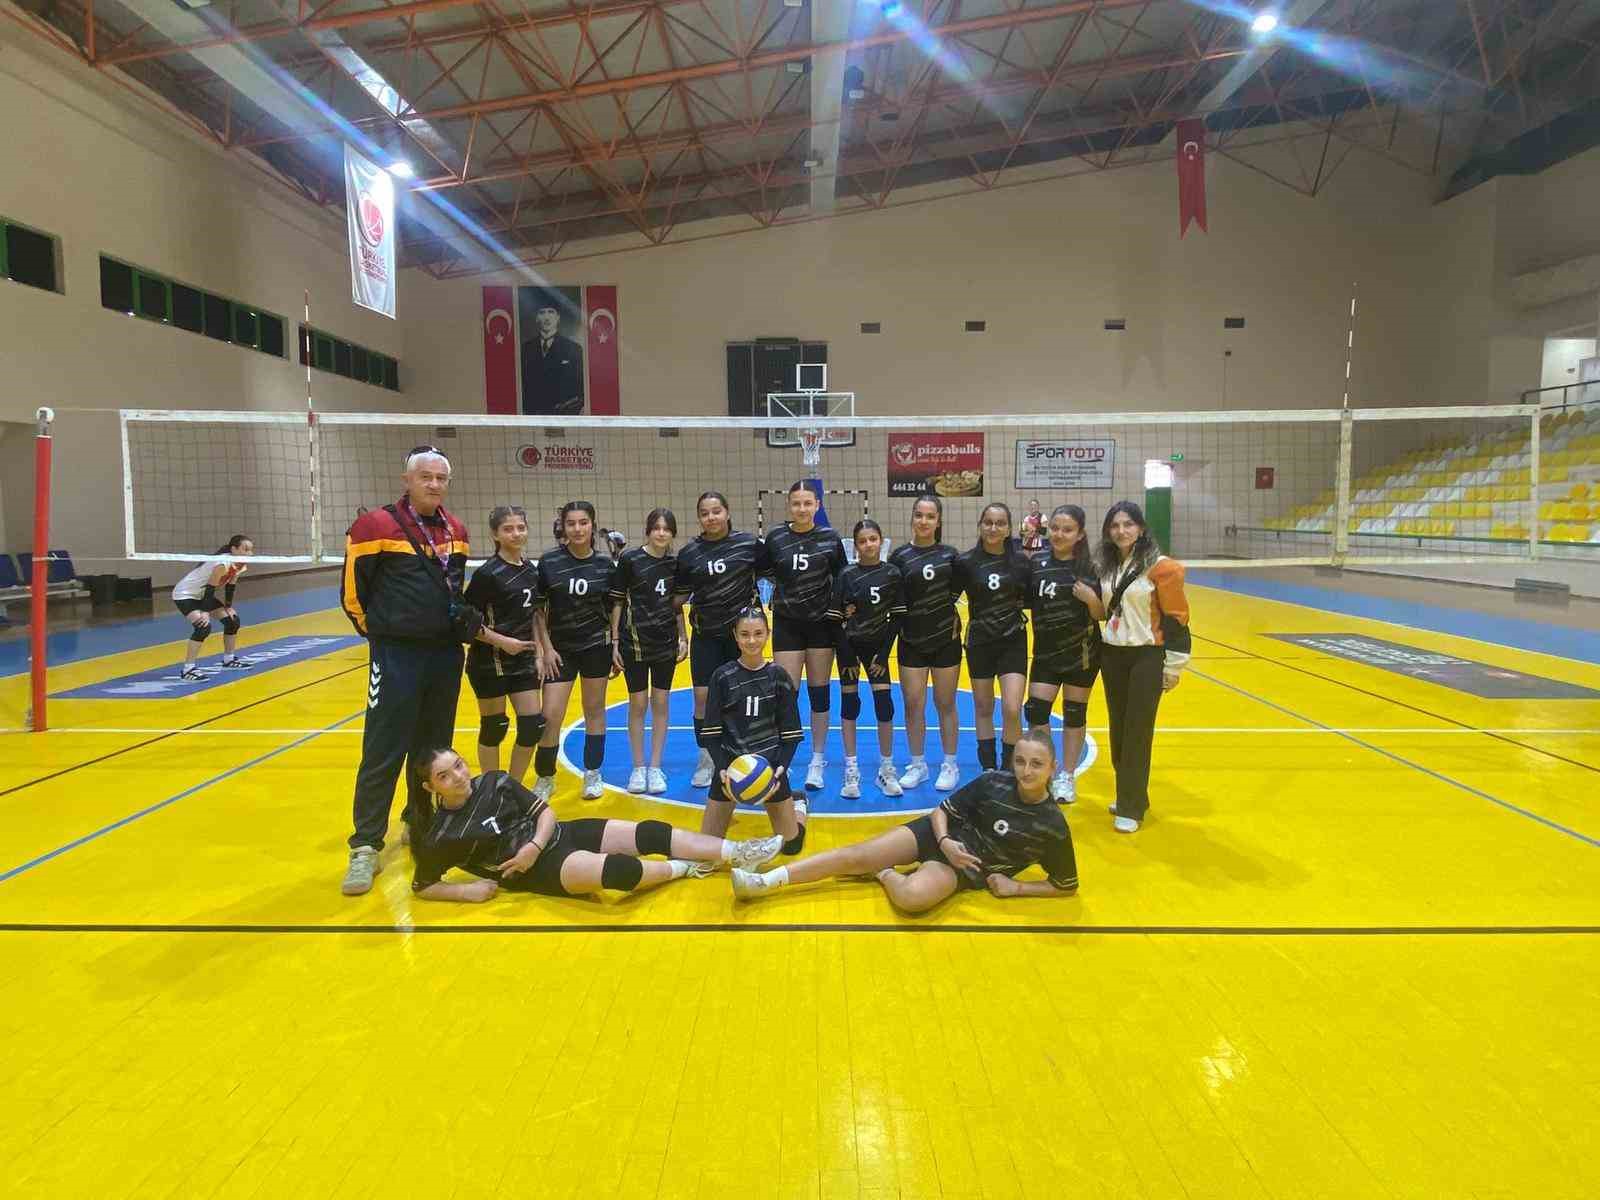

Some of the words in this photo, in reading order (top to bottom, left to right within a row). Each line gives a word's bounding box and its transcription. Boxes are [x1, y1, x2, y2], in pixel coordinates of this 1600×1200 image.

[544, 444, 593, 456] TÜRKİYE
[917, 444, 981, 456] pizzabulls
[1026, 447, 1105, 459] SPORTOTO
[707, 559, 727, 576] 16
[792, 553, 809, 571] 15
[922, 564, 936, 580] 6
[568, 578, 589, 595] 10
[654, 579, 667, 595] 4
[988, 573, 1000, 590] 8
[1038, 579, 1057, 598] 14
[522, 589, 532, 607] 2
[869, 586, 881, 604] 5
[745, 696, 759, 716] 11
[481, 816, 501, 834] 7
